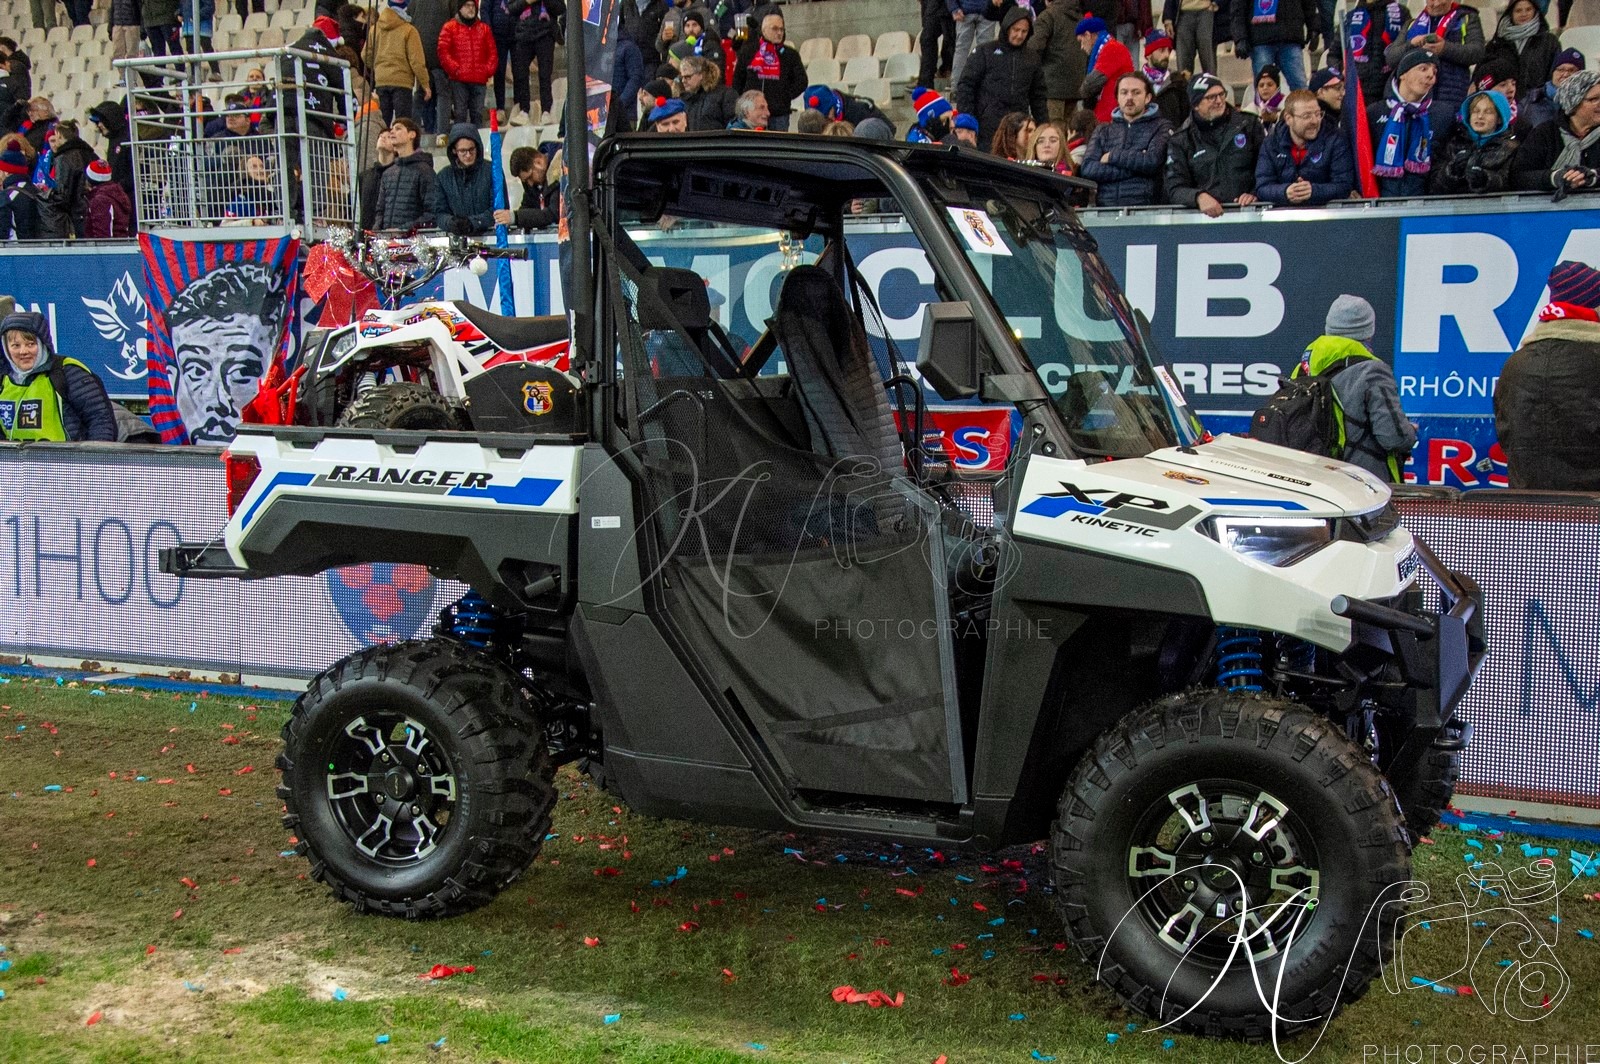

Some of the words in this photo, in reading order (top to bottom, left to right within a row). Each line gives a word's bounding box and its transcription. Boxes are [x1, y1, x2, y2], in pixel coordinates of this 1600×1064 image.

[22, 403, 39, 411] TOP
[22, 416, 37, 427] 14
[327, 465, 493, 489] RANGER
[1036, 481, 1170, 509] XP
[1071, 514, 1159, 537] KINETIC
